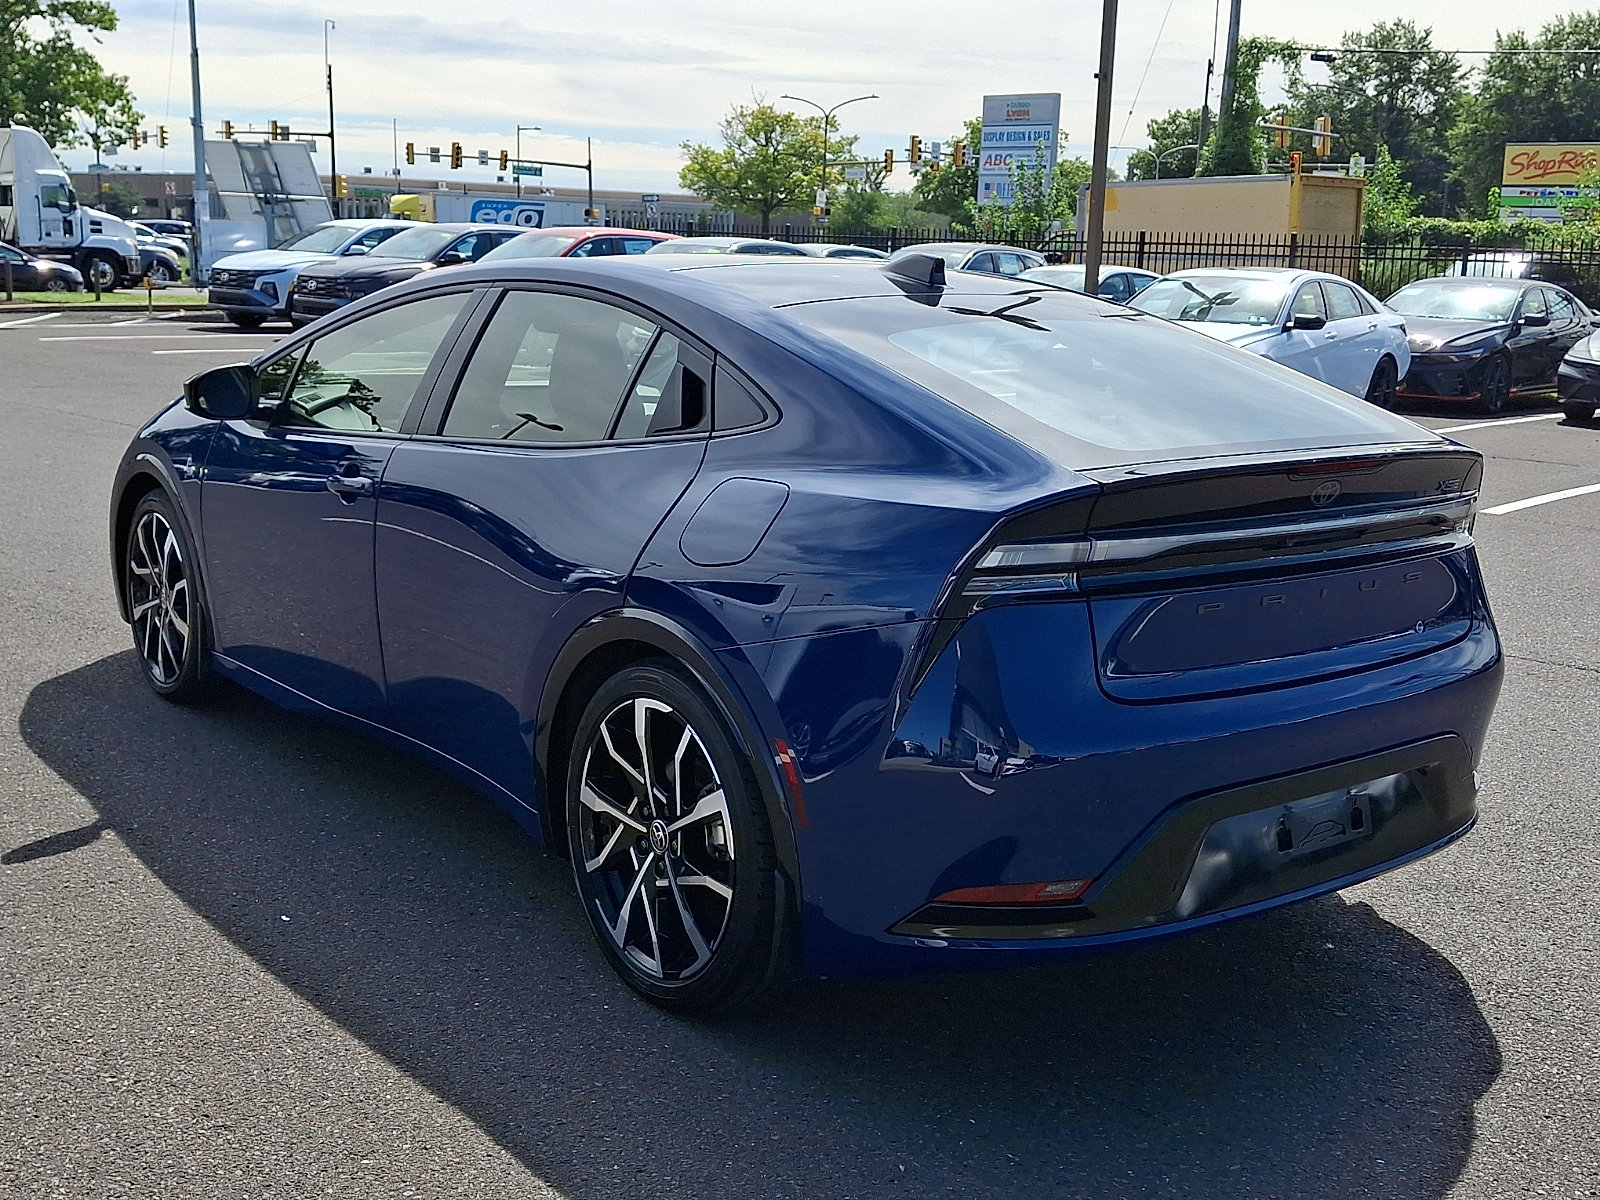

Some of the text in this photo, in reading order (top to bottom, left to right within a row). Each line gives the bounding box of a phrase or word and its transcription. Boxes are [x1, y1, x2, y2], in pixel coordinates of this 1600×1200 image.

[984, 130, 1051, 142] DISPLAY DESIGN & SALES
[984, 153, 1013, 167] ABC
[1437, 479, 1461, 492] XSE
[1196, 570, 1423, 616] PRIUS
